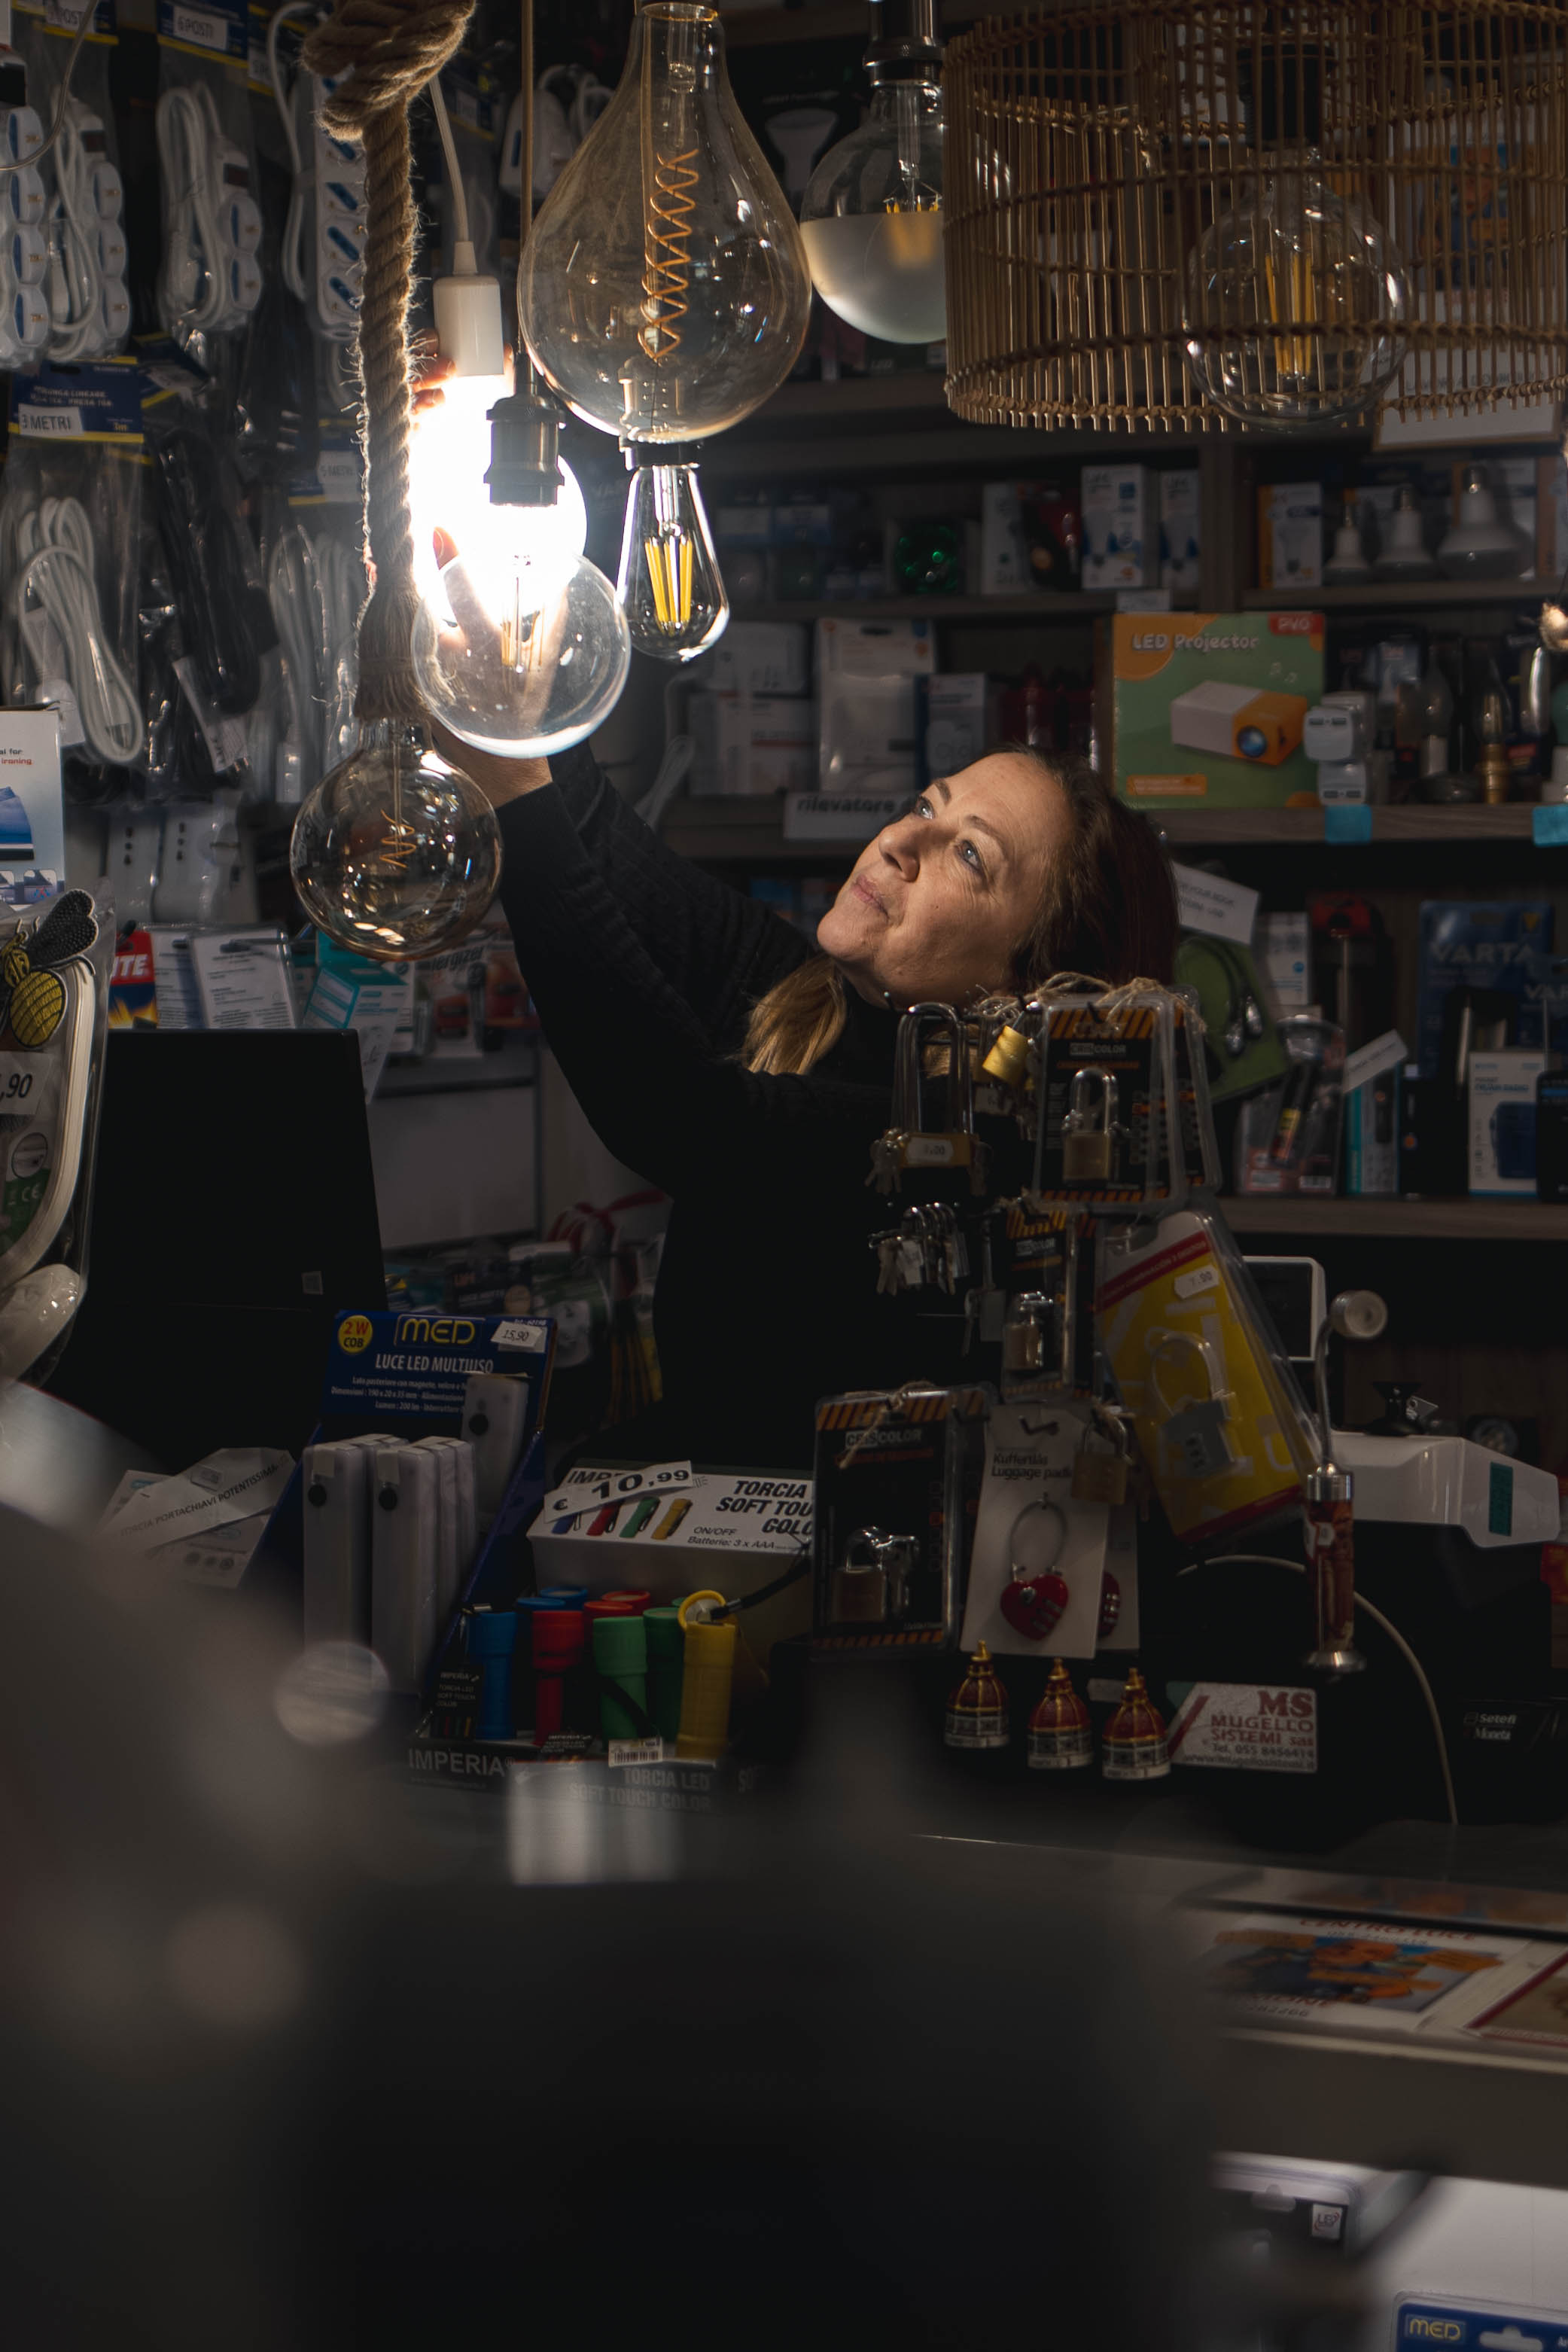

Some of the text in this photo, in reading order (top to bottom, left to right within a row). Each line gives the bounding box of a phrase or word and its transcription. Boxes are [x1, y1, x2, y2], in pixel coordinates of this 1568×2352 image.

[30, 415, 72, 432] METRI
[1132, 632, 1259, 654] LED Projector
[1, 757, 33, 766] ironing
[1429, 942, 1535, 964] VARTA
[343, 1321, 370, 1335] 2 W
[401, 1318, 476, 1345] MED
[343, 1337, 364, 1348] COB
[375, 1353, 495, 1374] LUCE LED MULTIUSO
[992, 1465, 1043, 1481] Luggage
[733, 1480, 808, 1498] TORCIA
[154, 1496, 217, 1524] PORTACHIAVI
[716, 1497, 812, 1516] SOFT TOU
[1258, 1690, 1314, 1717] MS
[1211, 1714, 1314, 1732] MUGELLO
[1211, 1729, 1282, 1745] SISTEMI
[624, 1767, 711, 1791] TORCIA LED
[1409, 2317, 1461, 2341] MED
